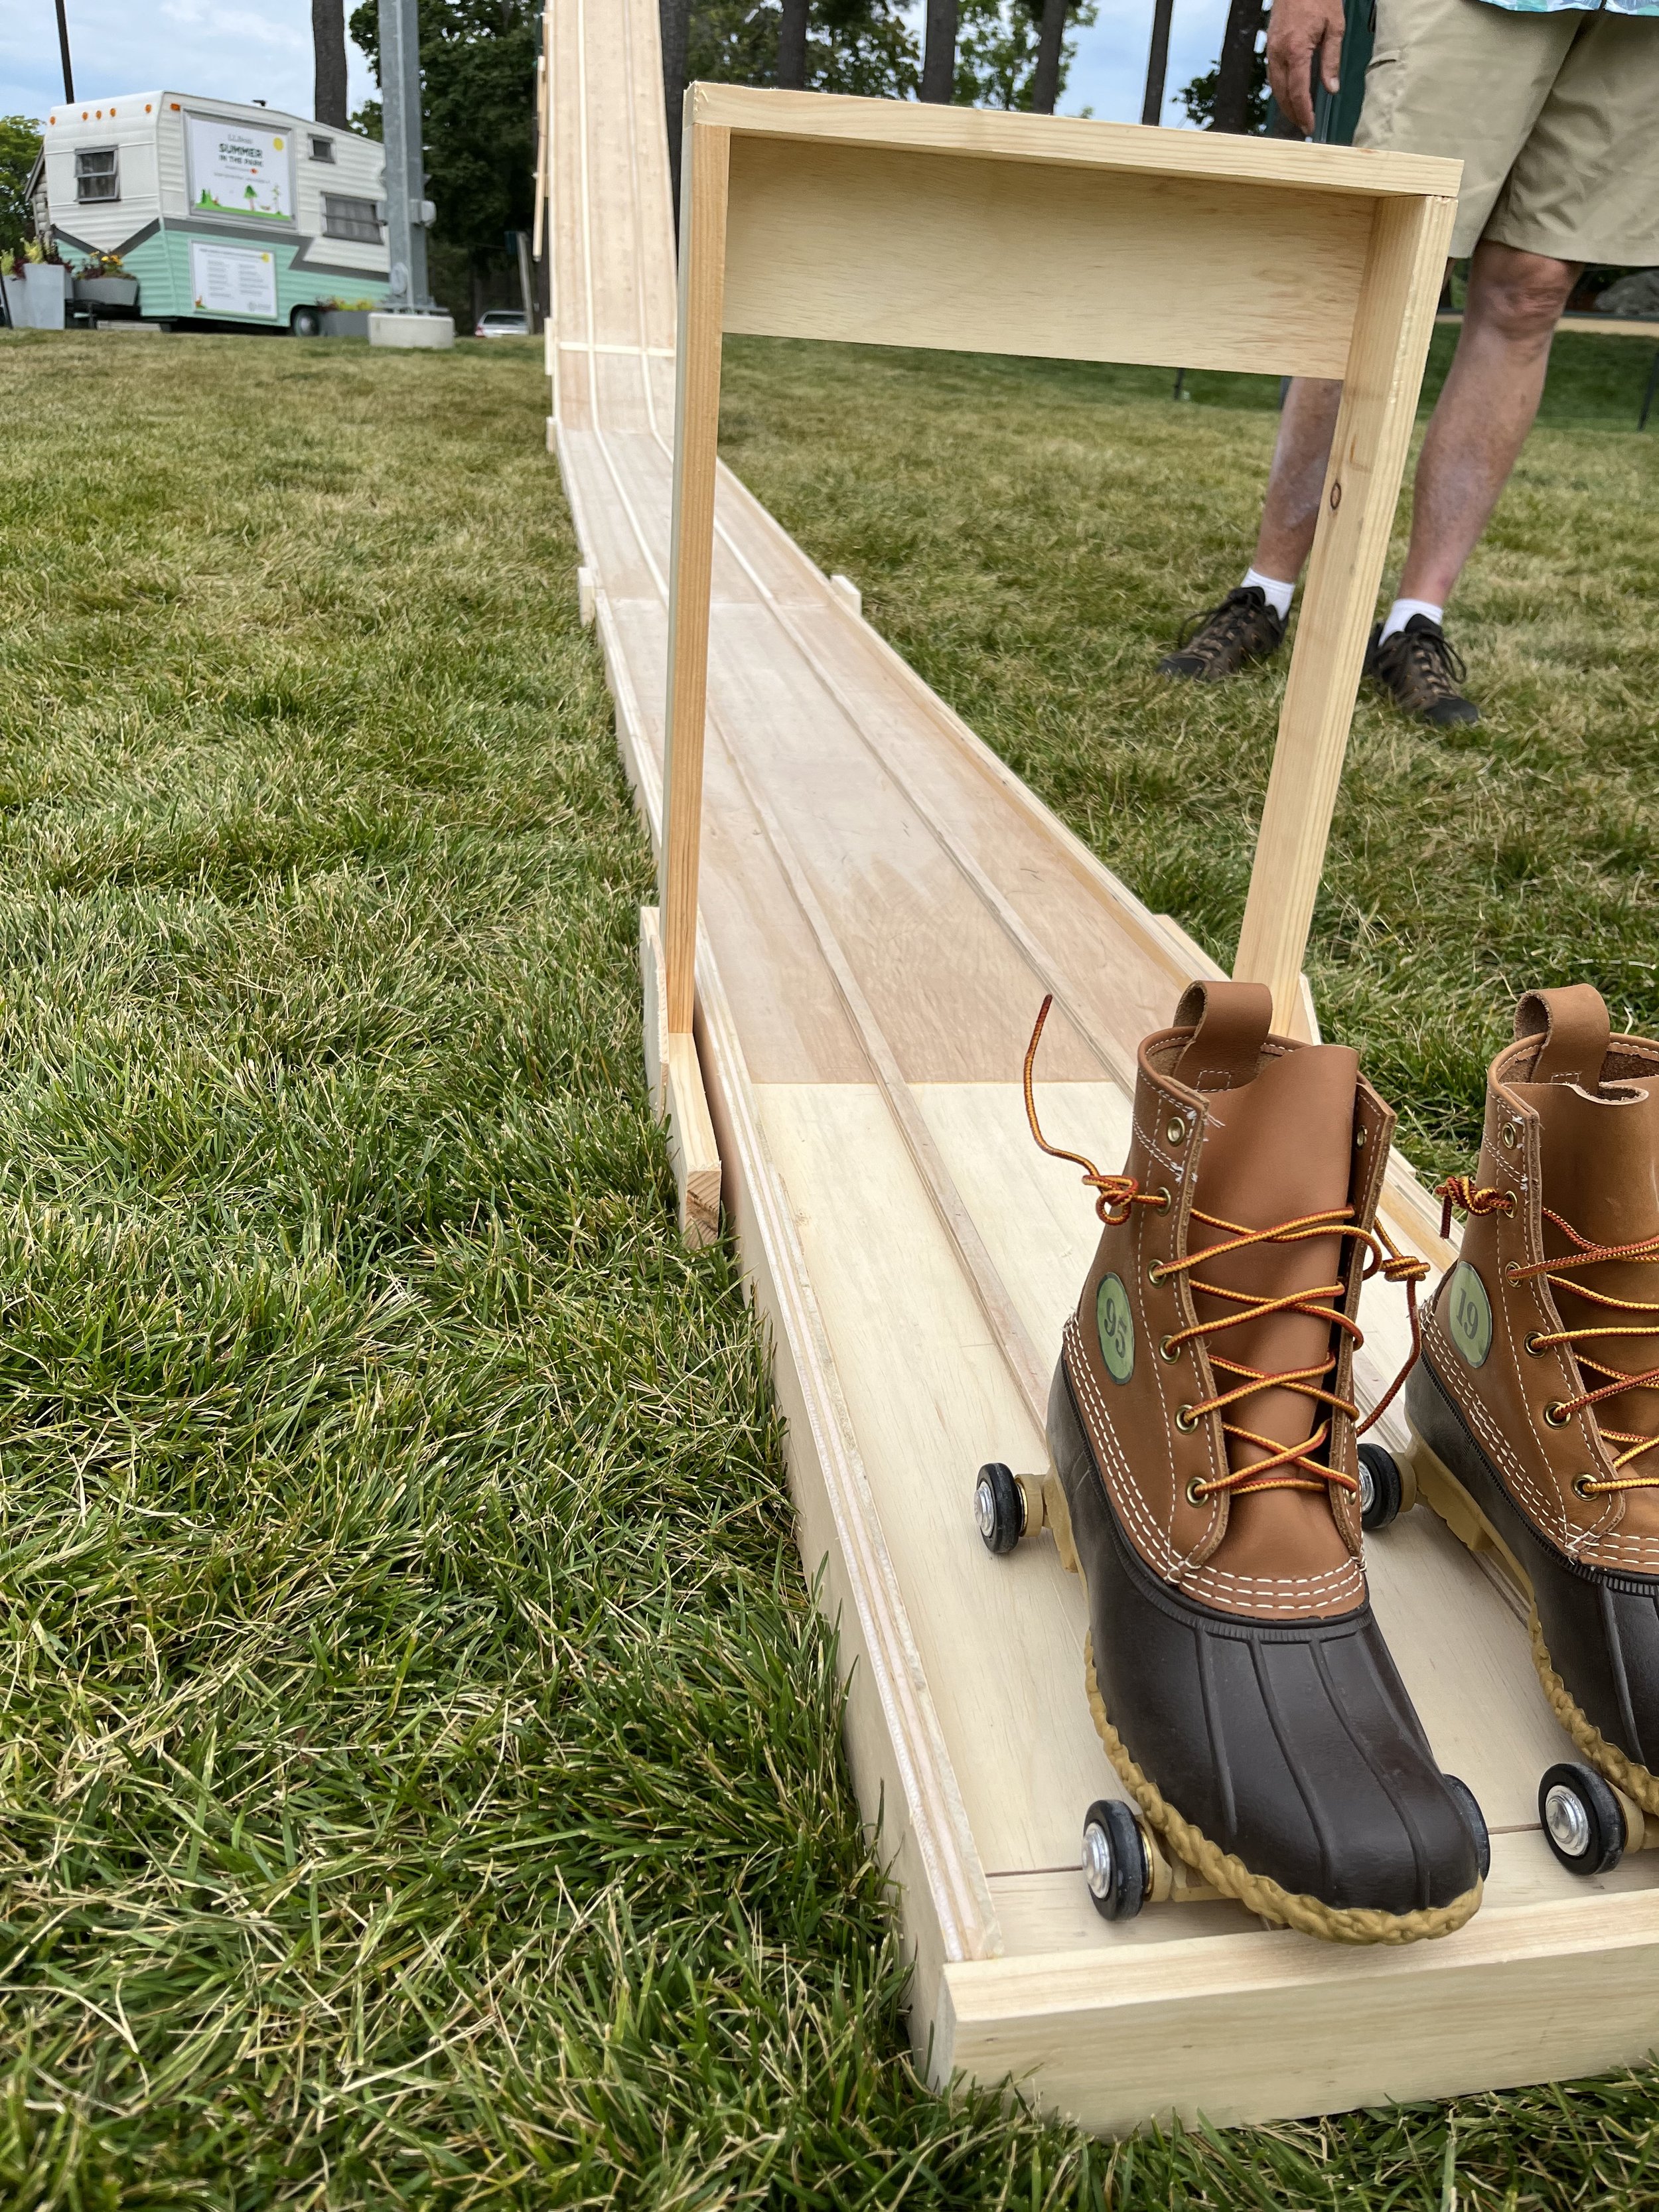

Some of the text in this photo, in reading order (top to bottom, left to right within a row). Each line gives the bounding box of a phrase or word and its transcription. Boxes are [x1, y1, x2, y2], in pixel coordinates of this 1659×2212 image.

[218, 143, 263, 159] SUMMER
[229, 155, 242, 165] THE
[244, 158, 263, 167] PARK
[1104, 1297, 1127, 1359] 95
[1456, 1287, 1479, 1340] 19
